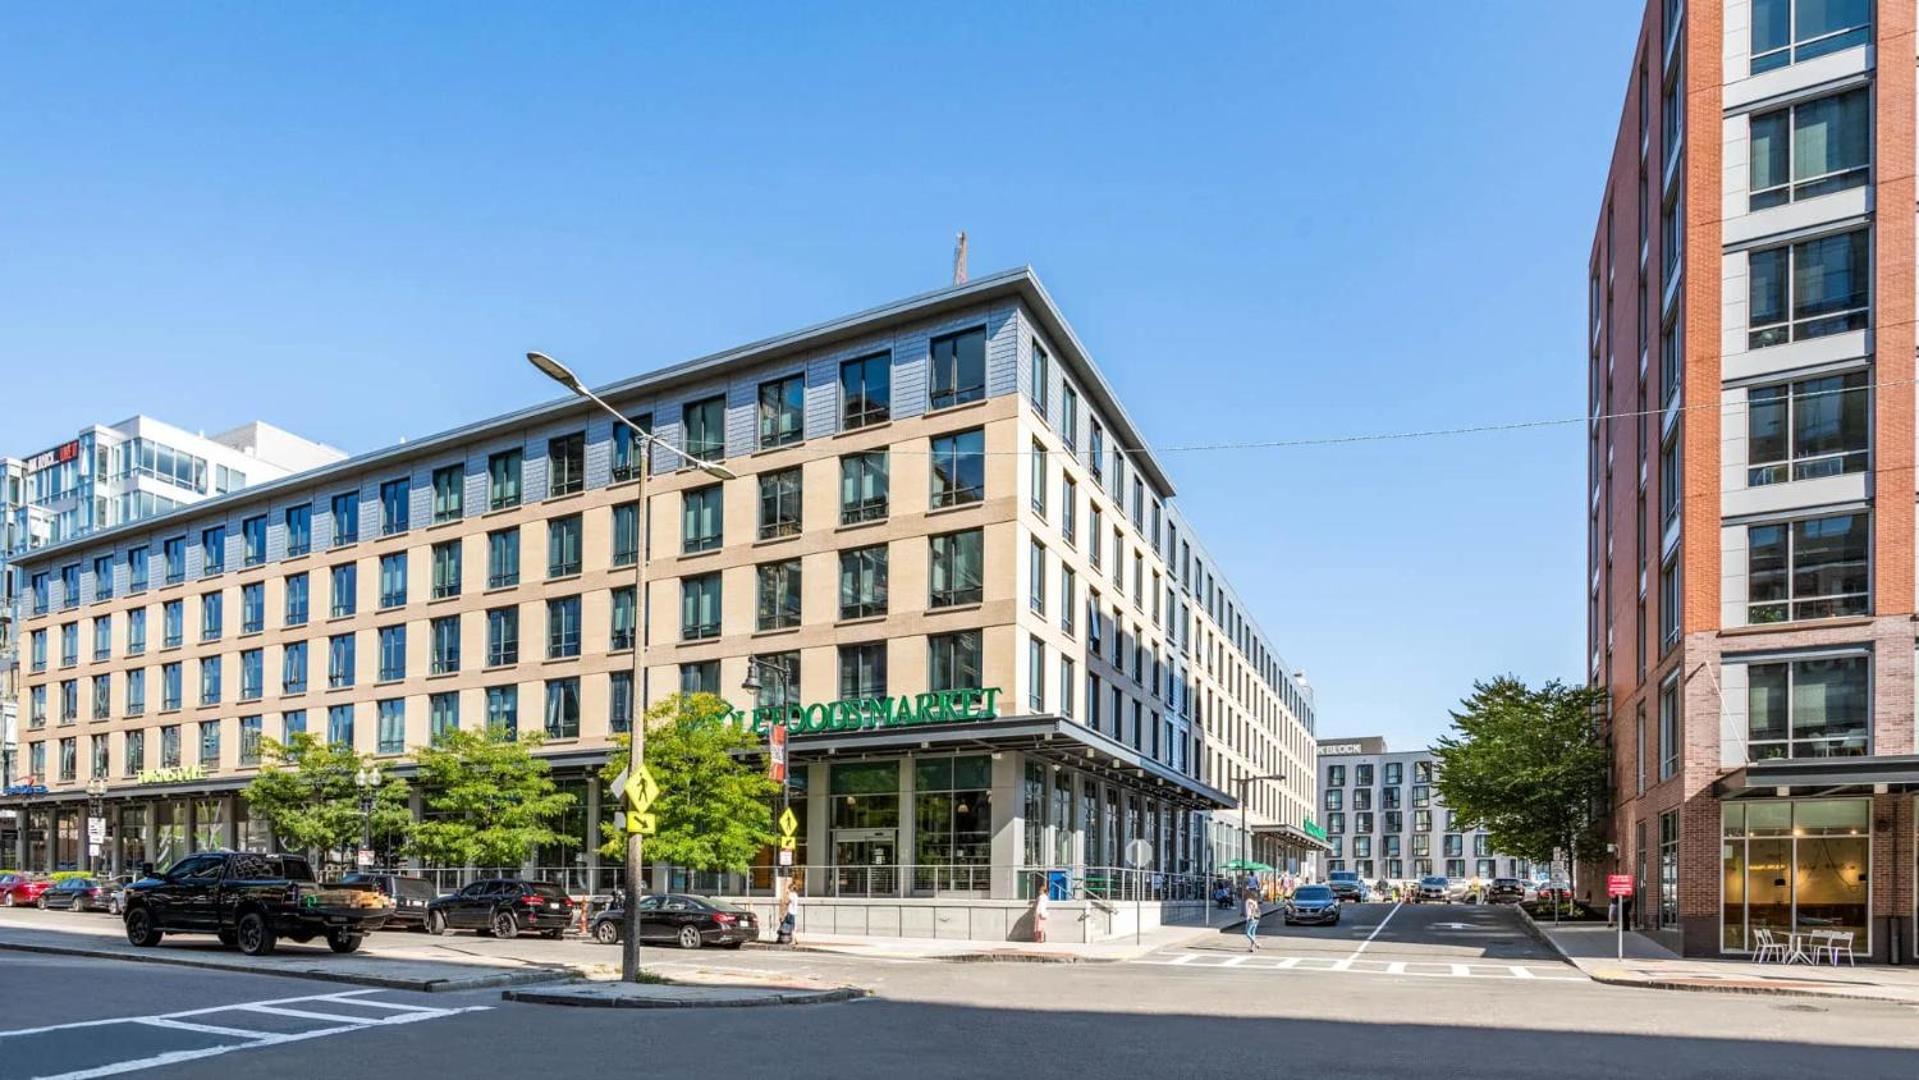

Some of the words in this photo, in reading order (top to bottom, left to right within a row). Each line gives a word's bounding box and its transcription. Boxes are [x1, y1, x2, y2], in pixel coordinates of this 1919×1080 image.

[772, 698, 864, 735] FOODS
[866, 686, 1004, 729] MARKET
[1327, 743, 1362, 754] BLOCK
